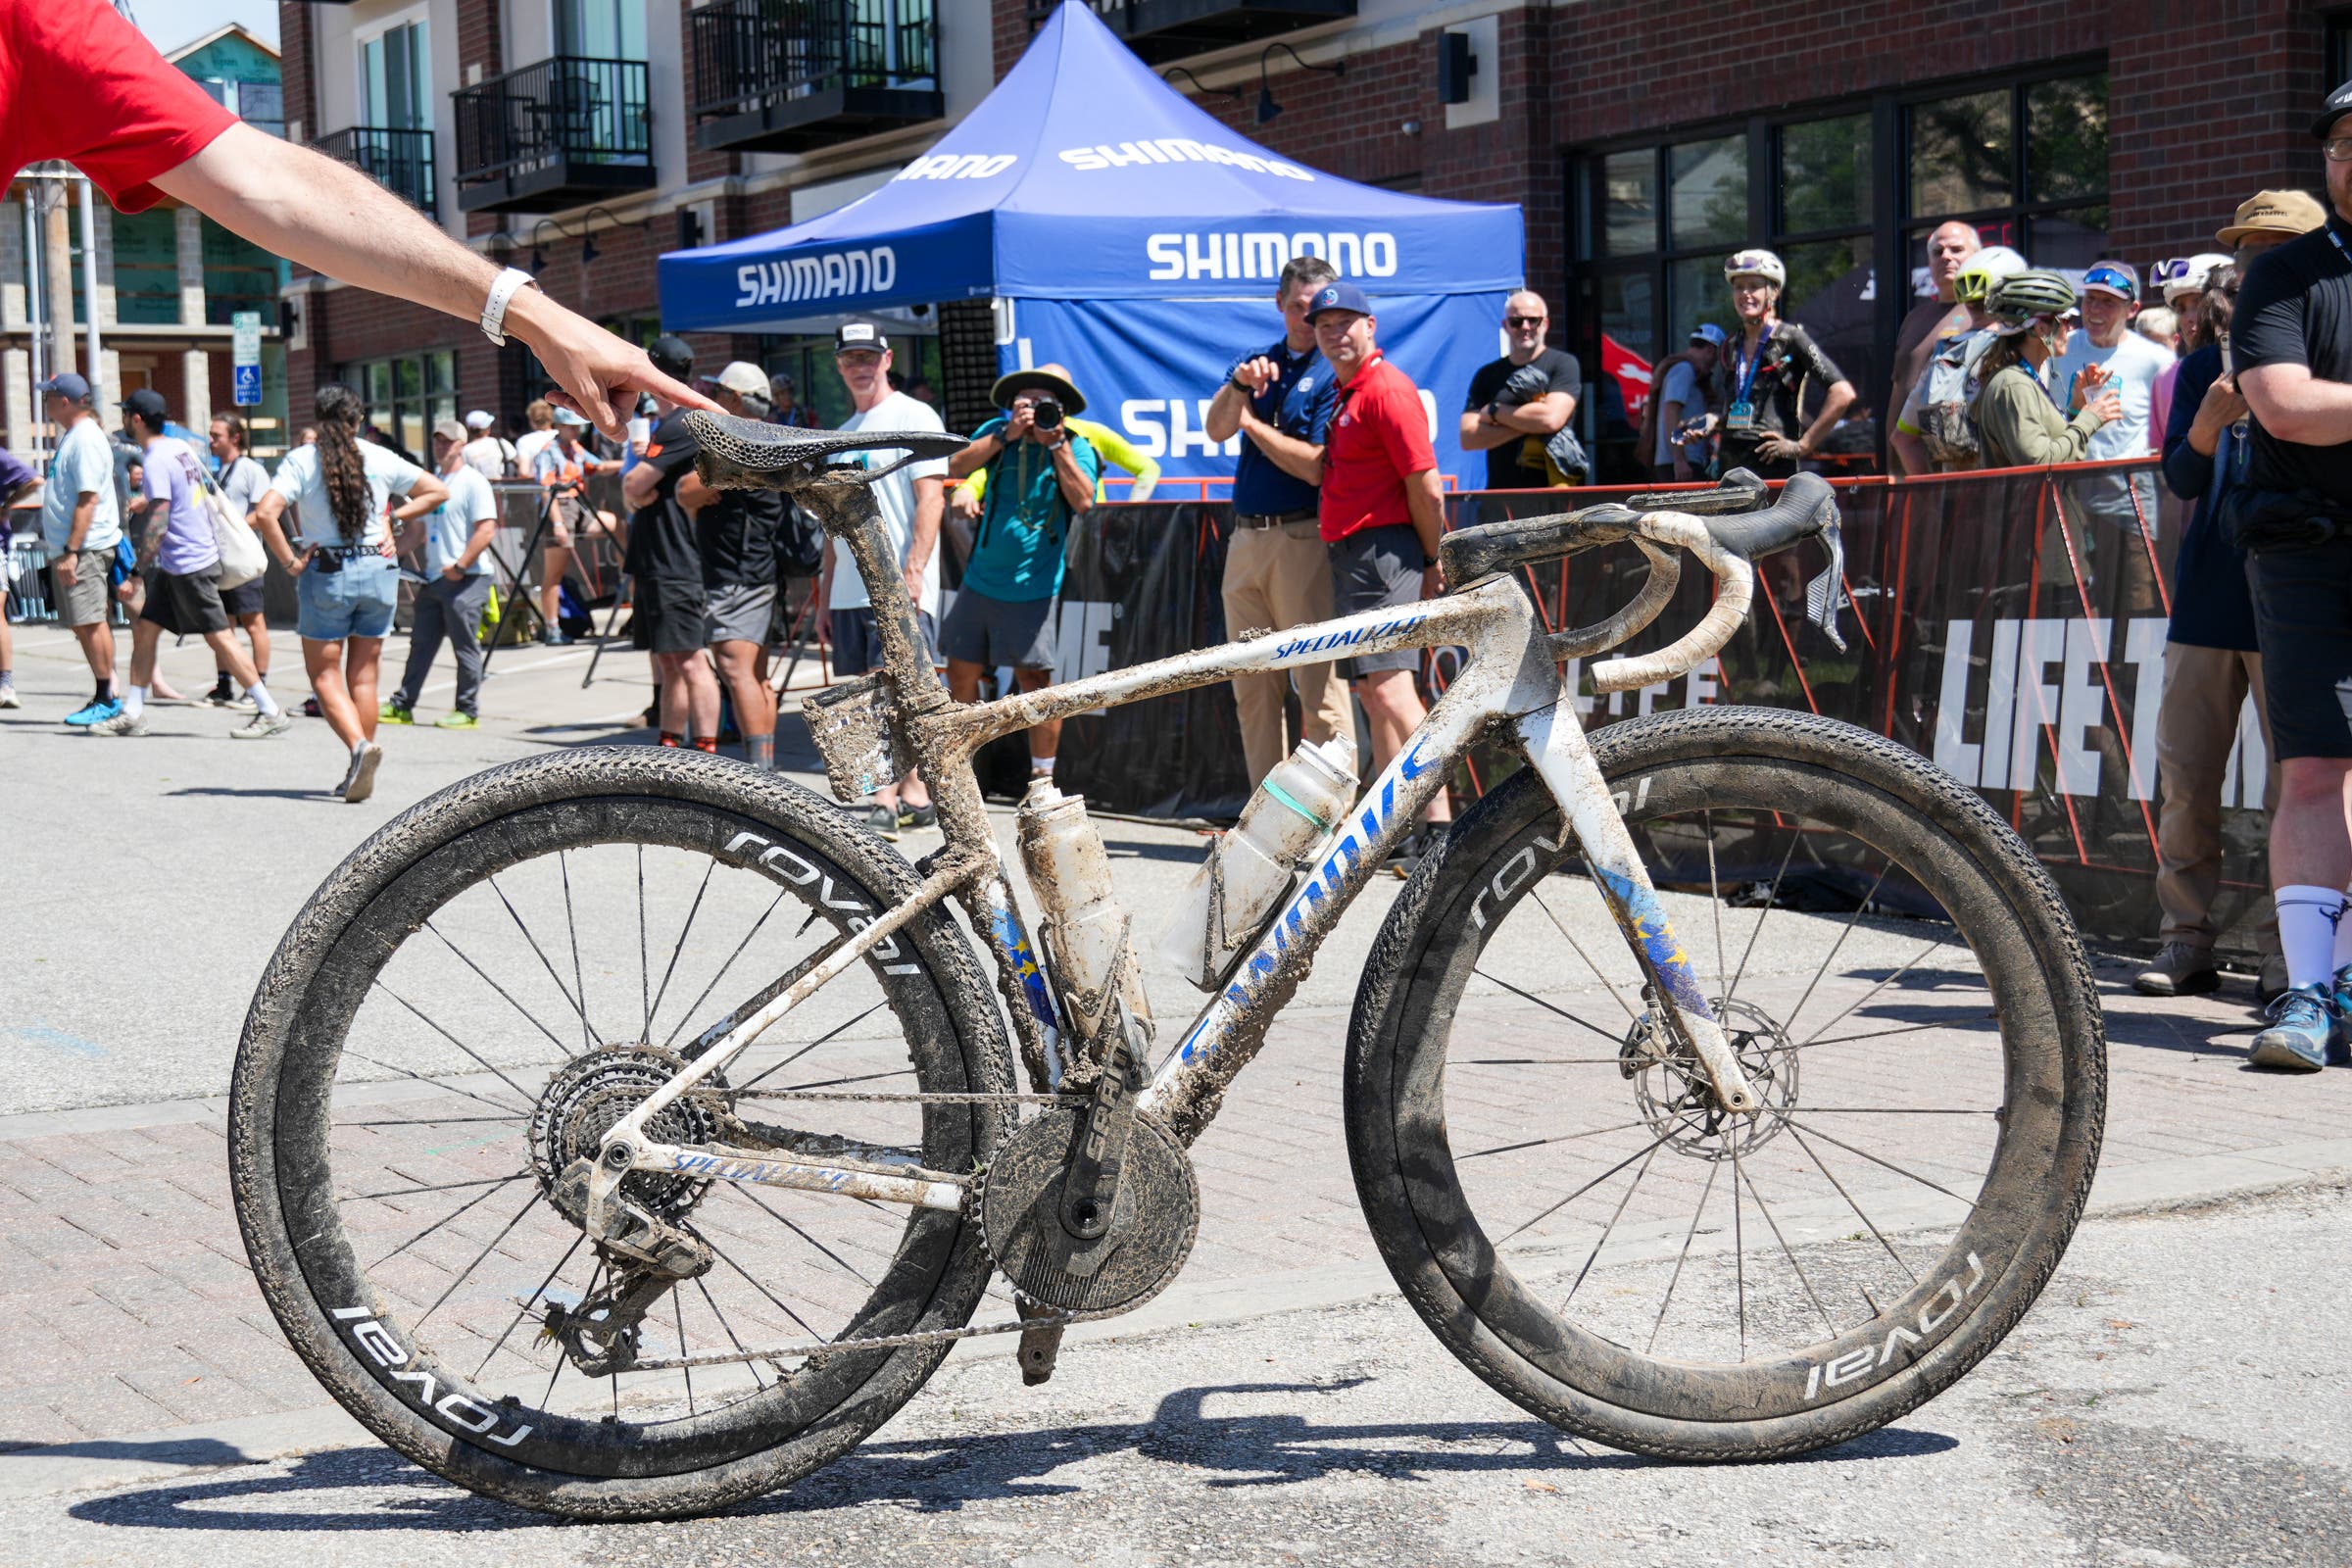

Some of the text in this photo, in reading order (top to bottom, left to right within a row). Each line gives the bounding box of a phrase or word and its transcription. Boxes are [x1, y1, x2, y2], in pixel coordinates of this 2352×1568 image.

[1058, 137, 1315, 182] SHIMANO
[736, 245, 897, 309] SHIMANO
[1270, 614, 1427, 661] SPECIALIZED
[1086, 1037, 1130, 1163] SRAM
[1802, 1250, 1985, 1399] roval
[331, 1304, 535, 1447] roval
